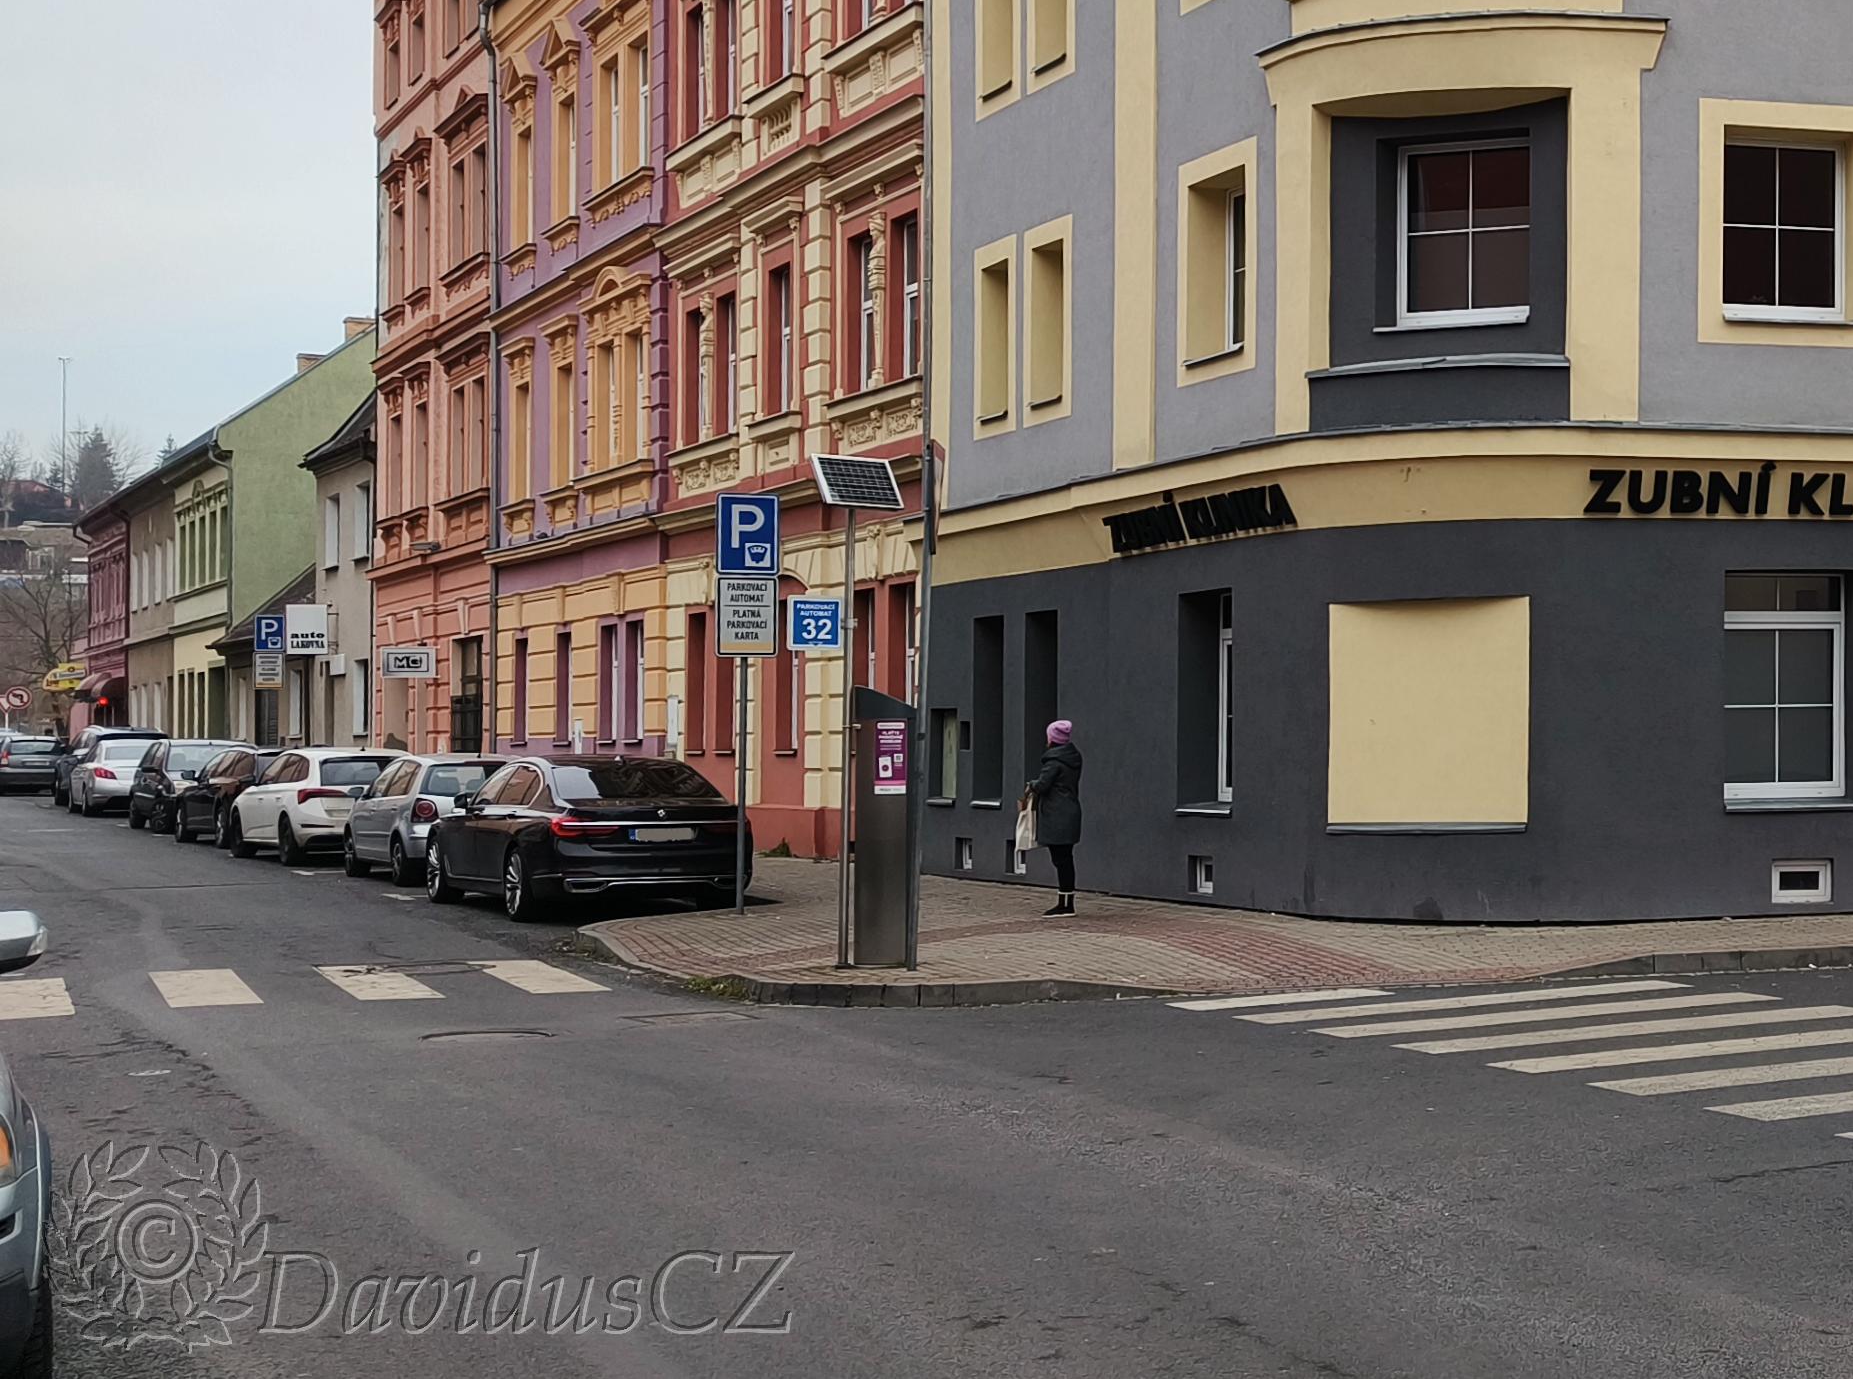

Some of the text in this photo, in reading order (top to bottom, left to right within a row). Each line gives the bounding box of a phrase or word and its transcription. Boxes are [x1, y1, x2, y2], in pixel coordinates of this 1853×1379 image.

[1583, 461, 1777, 516] ZUBNÍ
[731, 504, 765, 549] P
[727, 582, 767, 592] PARKOVACÍ
[730, 594, 765, 603] AUTOMAT
[732, 608, 761, 618] PLATNÁ
[261, 619, 278, 640] P
[727, 620, 767, 629] PARKOVACÍ
[801, 619, 832, 640] 32
[734, 631, 759, 640] KARTA
[290, 640, 325, 649] LAKOVNA
